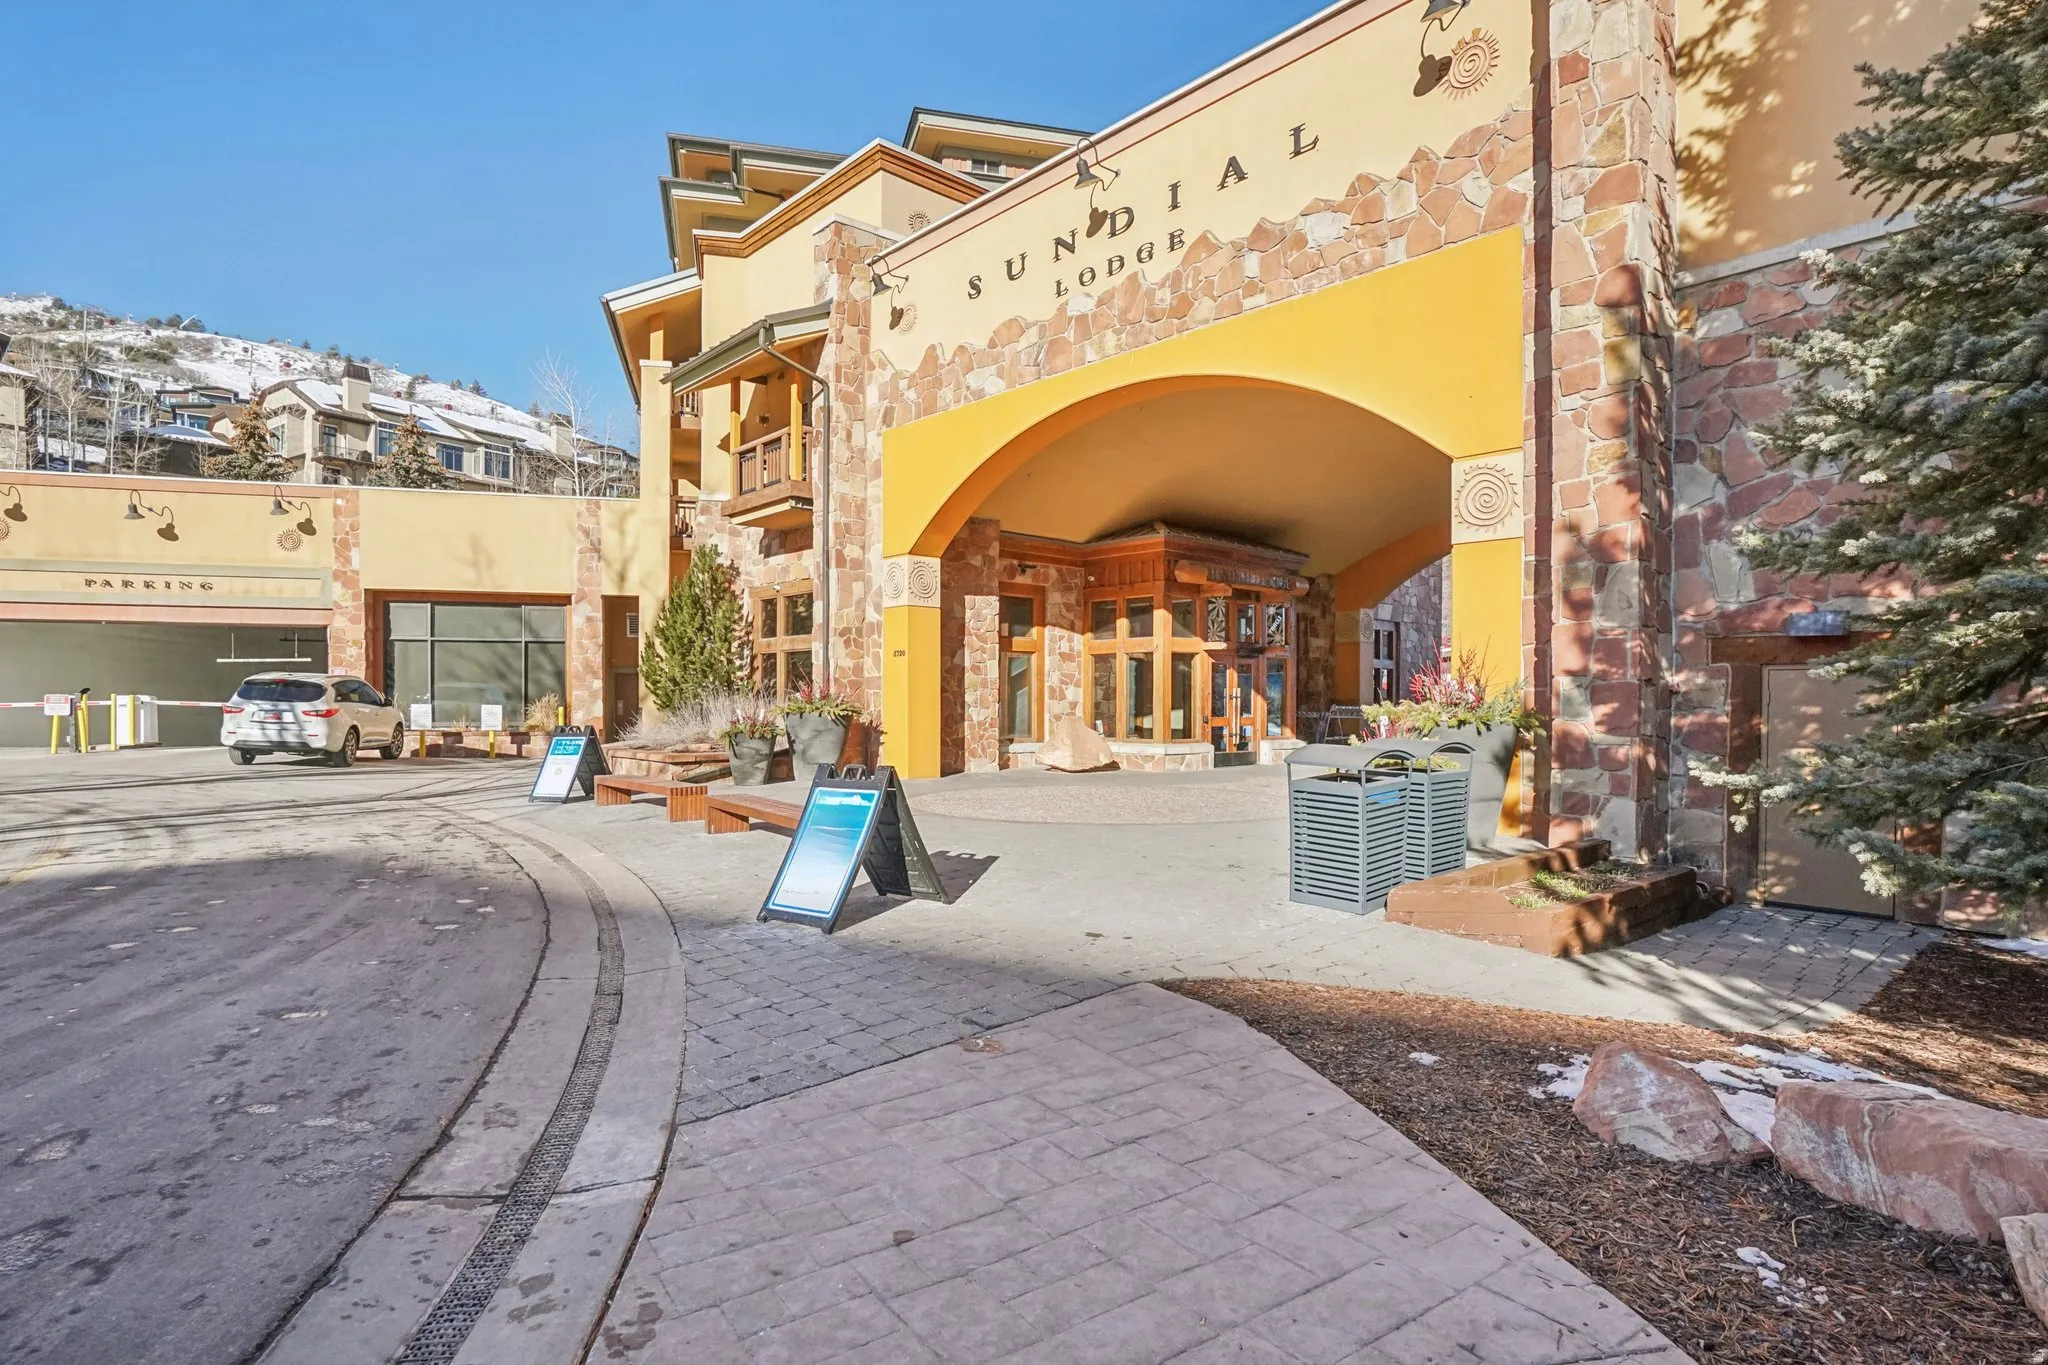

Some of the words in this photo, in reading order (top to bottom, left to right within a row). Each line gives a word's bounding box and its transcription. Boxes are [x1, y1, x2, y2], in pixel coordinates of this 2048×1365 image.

[967, 122, 1320, 300] SUNDIAL
[1054, 228, 1188, 299] LODGE
[84, 578, 214, 591] PARKING
